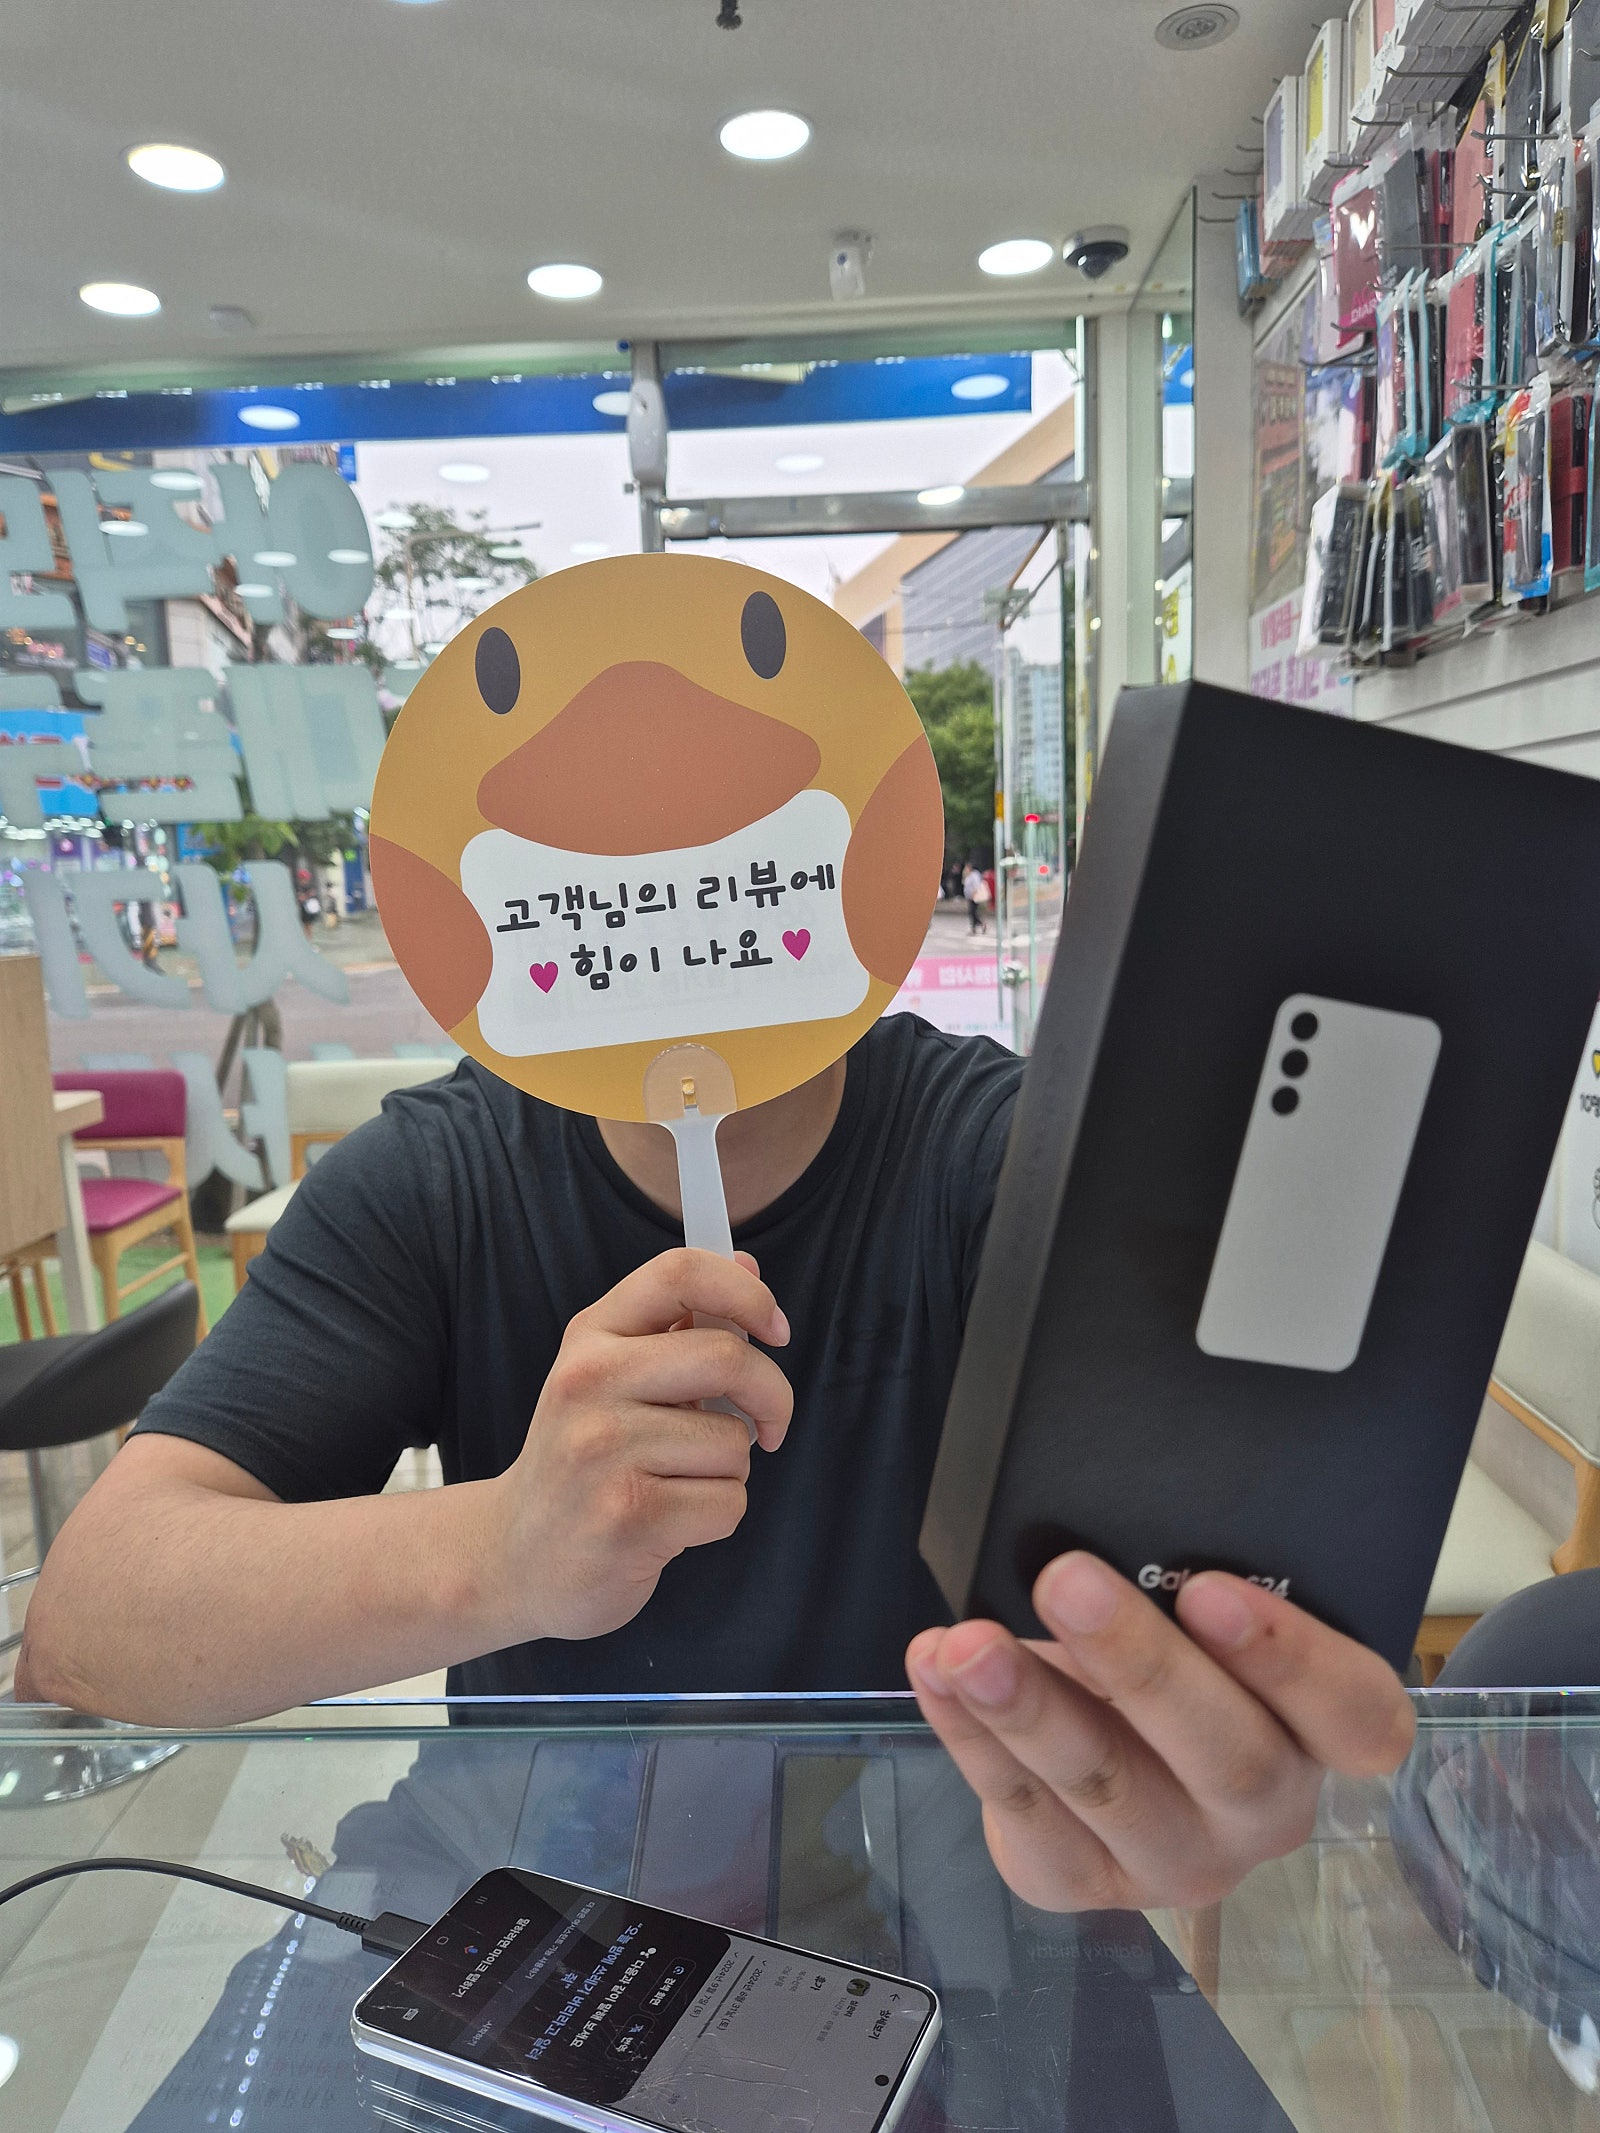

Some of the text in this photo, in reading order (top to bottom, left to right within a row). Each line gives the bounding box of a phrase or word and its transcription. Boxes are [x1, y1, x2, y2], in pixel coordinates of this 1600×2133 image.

[1351, 297, 1377, 323] DIAR
[497, 861, 835, 932] 고객님의 리뷰에
[571, 930, 772, 990] 힘이 나요
[554, 1918, 579, 1945] 어시스턴트
[451, 1916, 530, 1998] 말하려면 마이크 탭하기
[524, 1956, 547, 1979] 사용하기
[600, 1943, 625, 1965] 밤에
[577, 1964, 607, 1995] 쓰레기
[713, 1958, 734, 1981] 2024년
[742, 1967, 762, 1991] 2024년
[809, 1974, 826, 1991] 휴가
[569, 1958, 644, 2048] 다음과 같이 말해 보세요
[648, 1975, 675, 2006] 검색 화면
[543, 1995, 584, 2037] 버리라고
[867, 2010, 891, 2040] 상세보기
[524, 2036, 551, 2060] 알려
[614, 2035, 632, 2053] 번역
